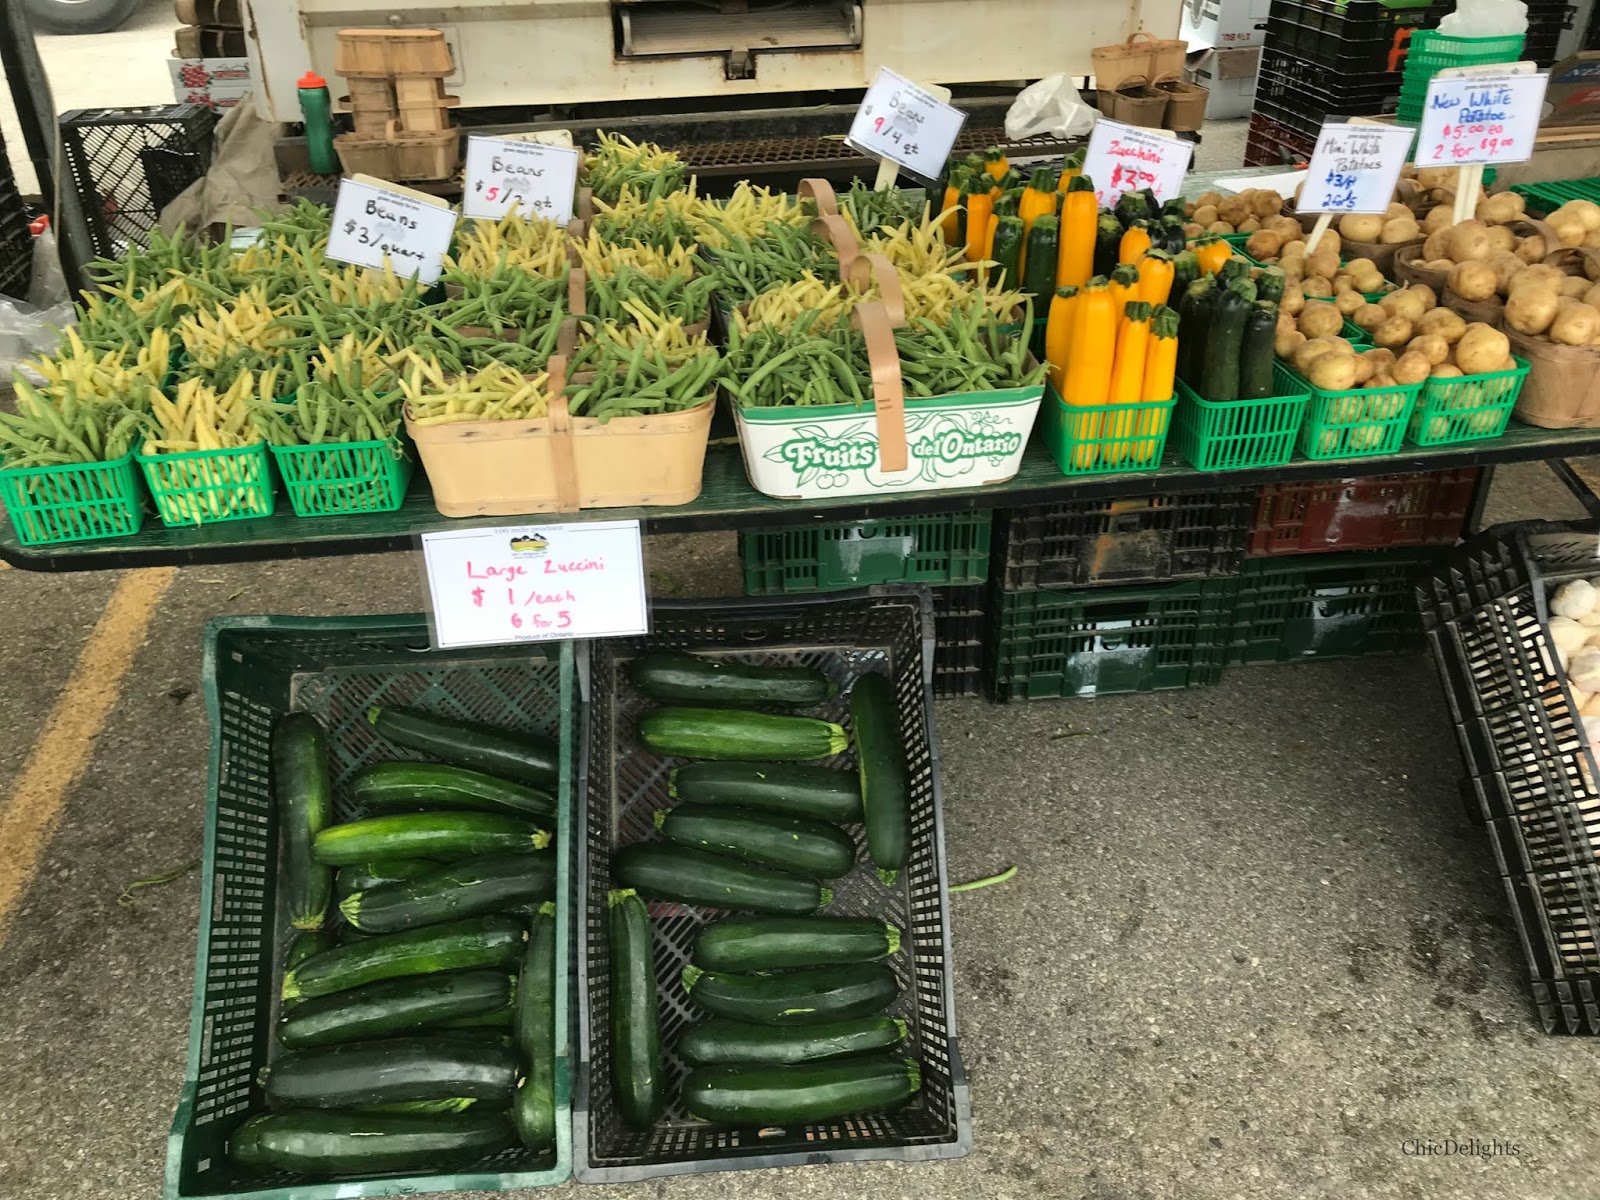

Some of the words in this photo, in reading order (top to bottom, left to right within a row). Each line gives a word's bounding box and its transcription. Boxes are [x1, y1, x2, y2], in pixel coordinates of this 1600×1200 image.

[1433, 144, 1444, 159] 2
[1452, 143, 1474, 158] for
[492, 156, 545, 177] Beans
[366, 199, 418, 230] Beans
[782, 437, 876, 472] Fruits
[467, 561, 528, 582] Large
[544, 558, 604, 574] Zuccini
[511, 613, 522, 628] 6
[533, 614, 552, 628] for
[557, 611, 572, 628] 5
